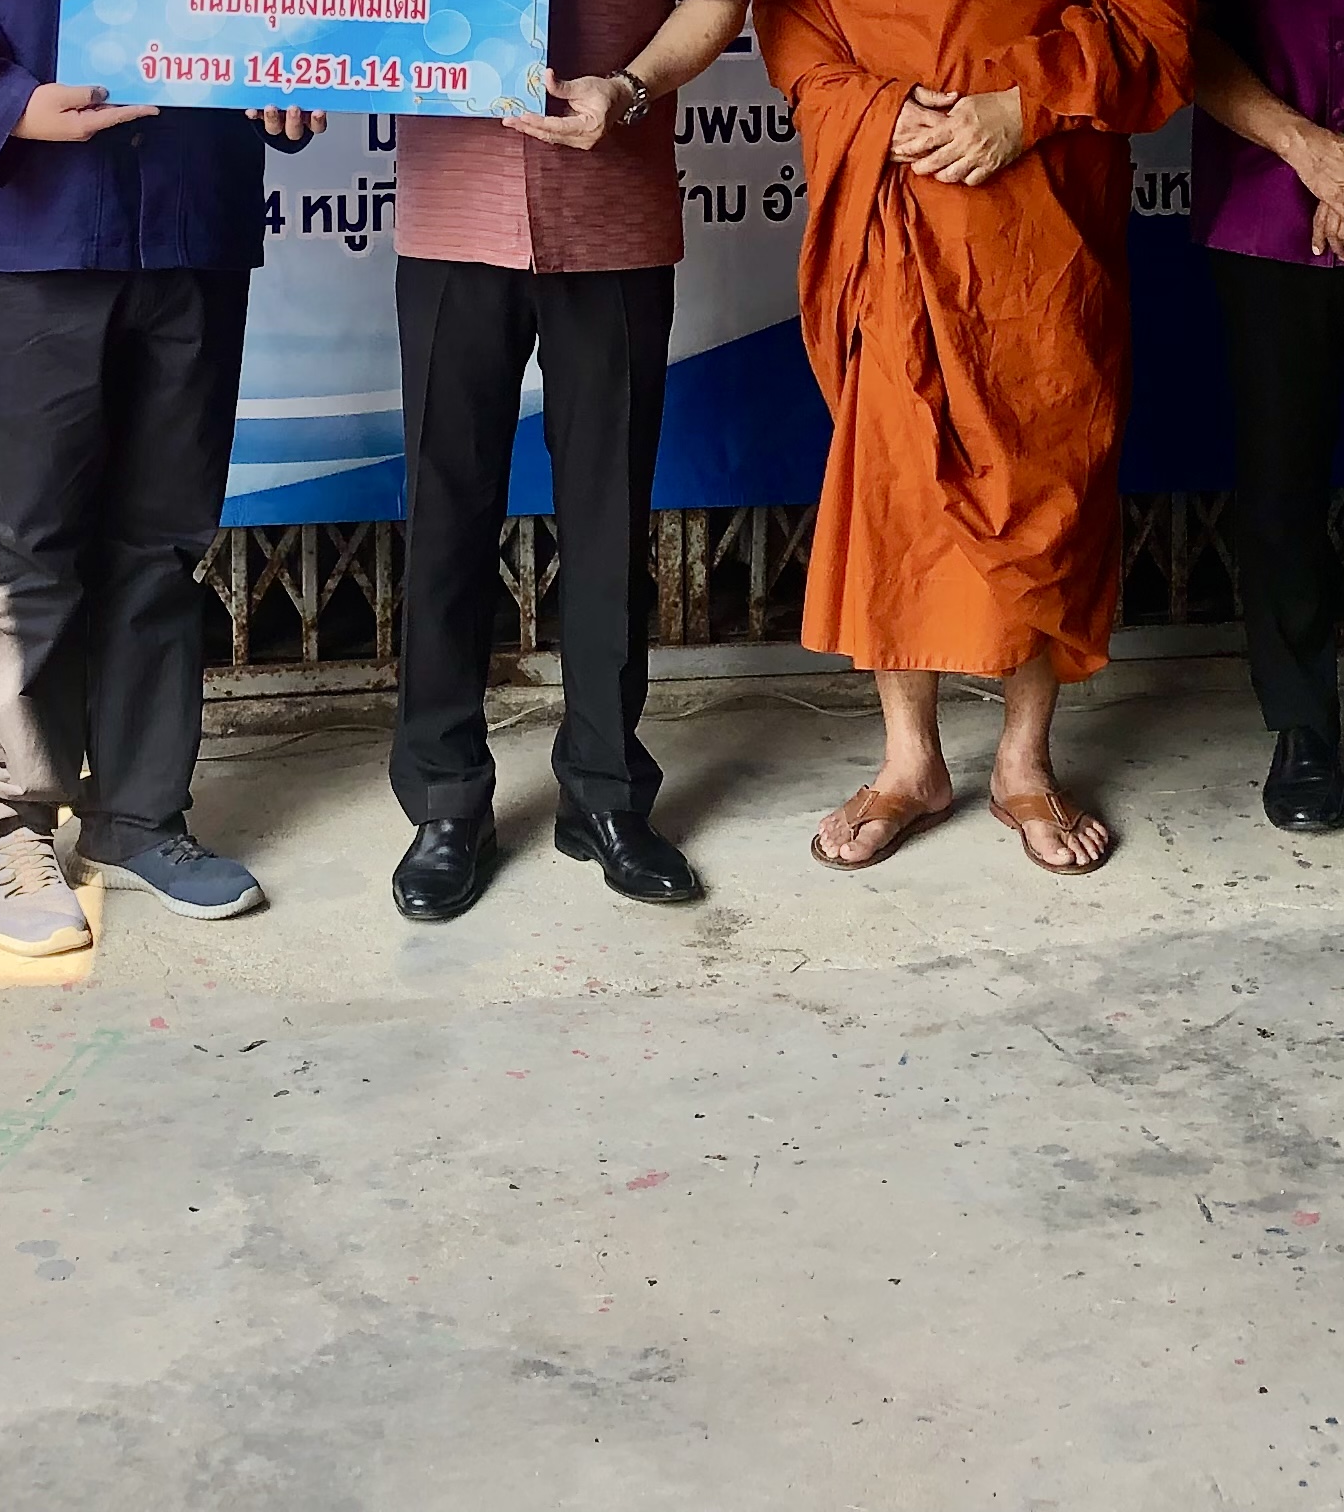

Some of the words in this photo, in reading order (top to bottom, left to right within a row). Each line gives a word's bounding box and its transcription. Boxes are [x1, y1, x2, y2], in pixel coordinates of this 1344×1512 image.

[140, 43, 231, 83] จำนวน
[248, 54, 401, 91] 14,251.14
[413, 62, 468, 90] บาท
